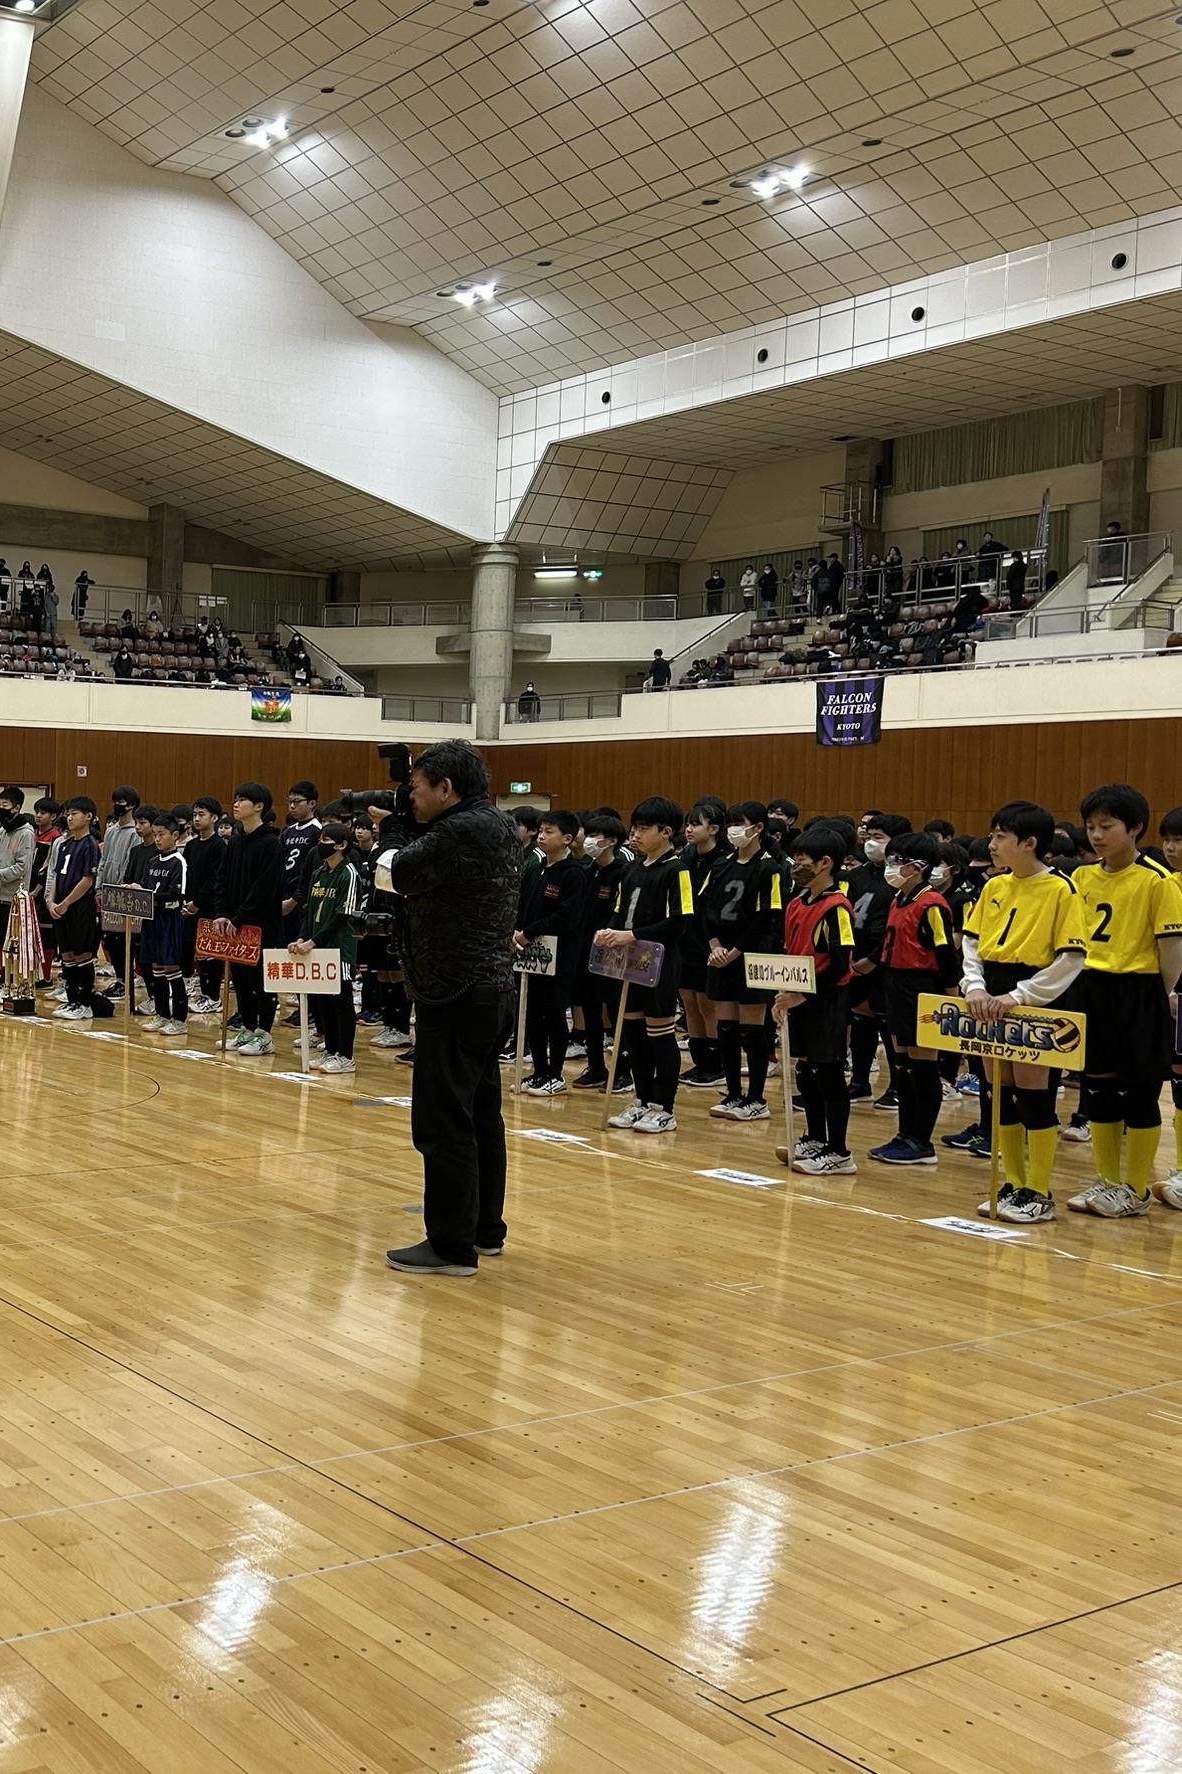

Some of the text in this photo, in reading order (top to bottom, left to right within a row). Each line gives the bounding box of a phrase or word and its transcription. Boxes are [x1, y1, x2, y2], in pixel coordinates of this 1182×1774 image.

[826, 691, 873, 705] FALCON
[820, 703, 877, 716] FIGHTERS
[836, 722, 861, 731] KYOTO
[60, 853, 72, 875] 1
[285, 848, 301, 871] 3
[625, 886, 641, 929] 1
[720, 879, 745, 921] 2
[854, 891, 875, 929] 4
[997, 907, 1018, 946] 1
[1090, 902, 1114, 943] 2
[267, 961, 337, 981] 精華D.B.C
[959, 1040, 1041, 1062] 長岡京ロケッツ
